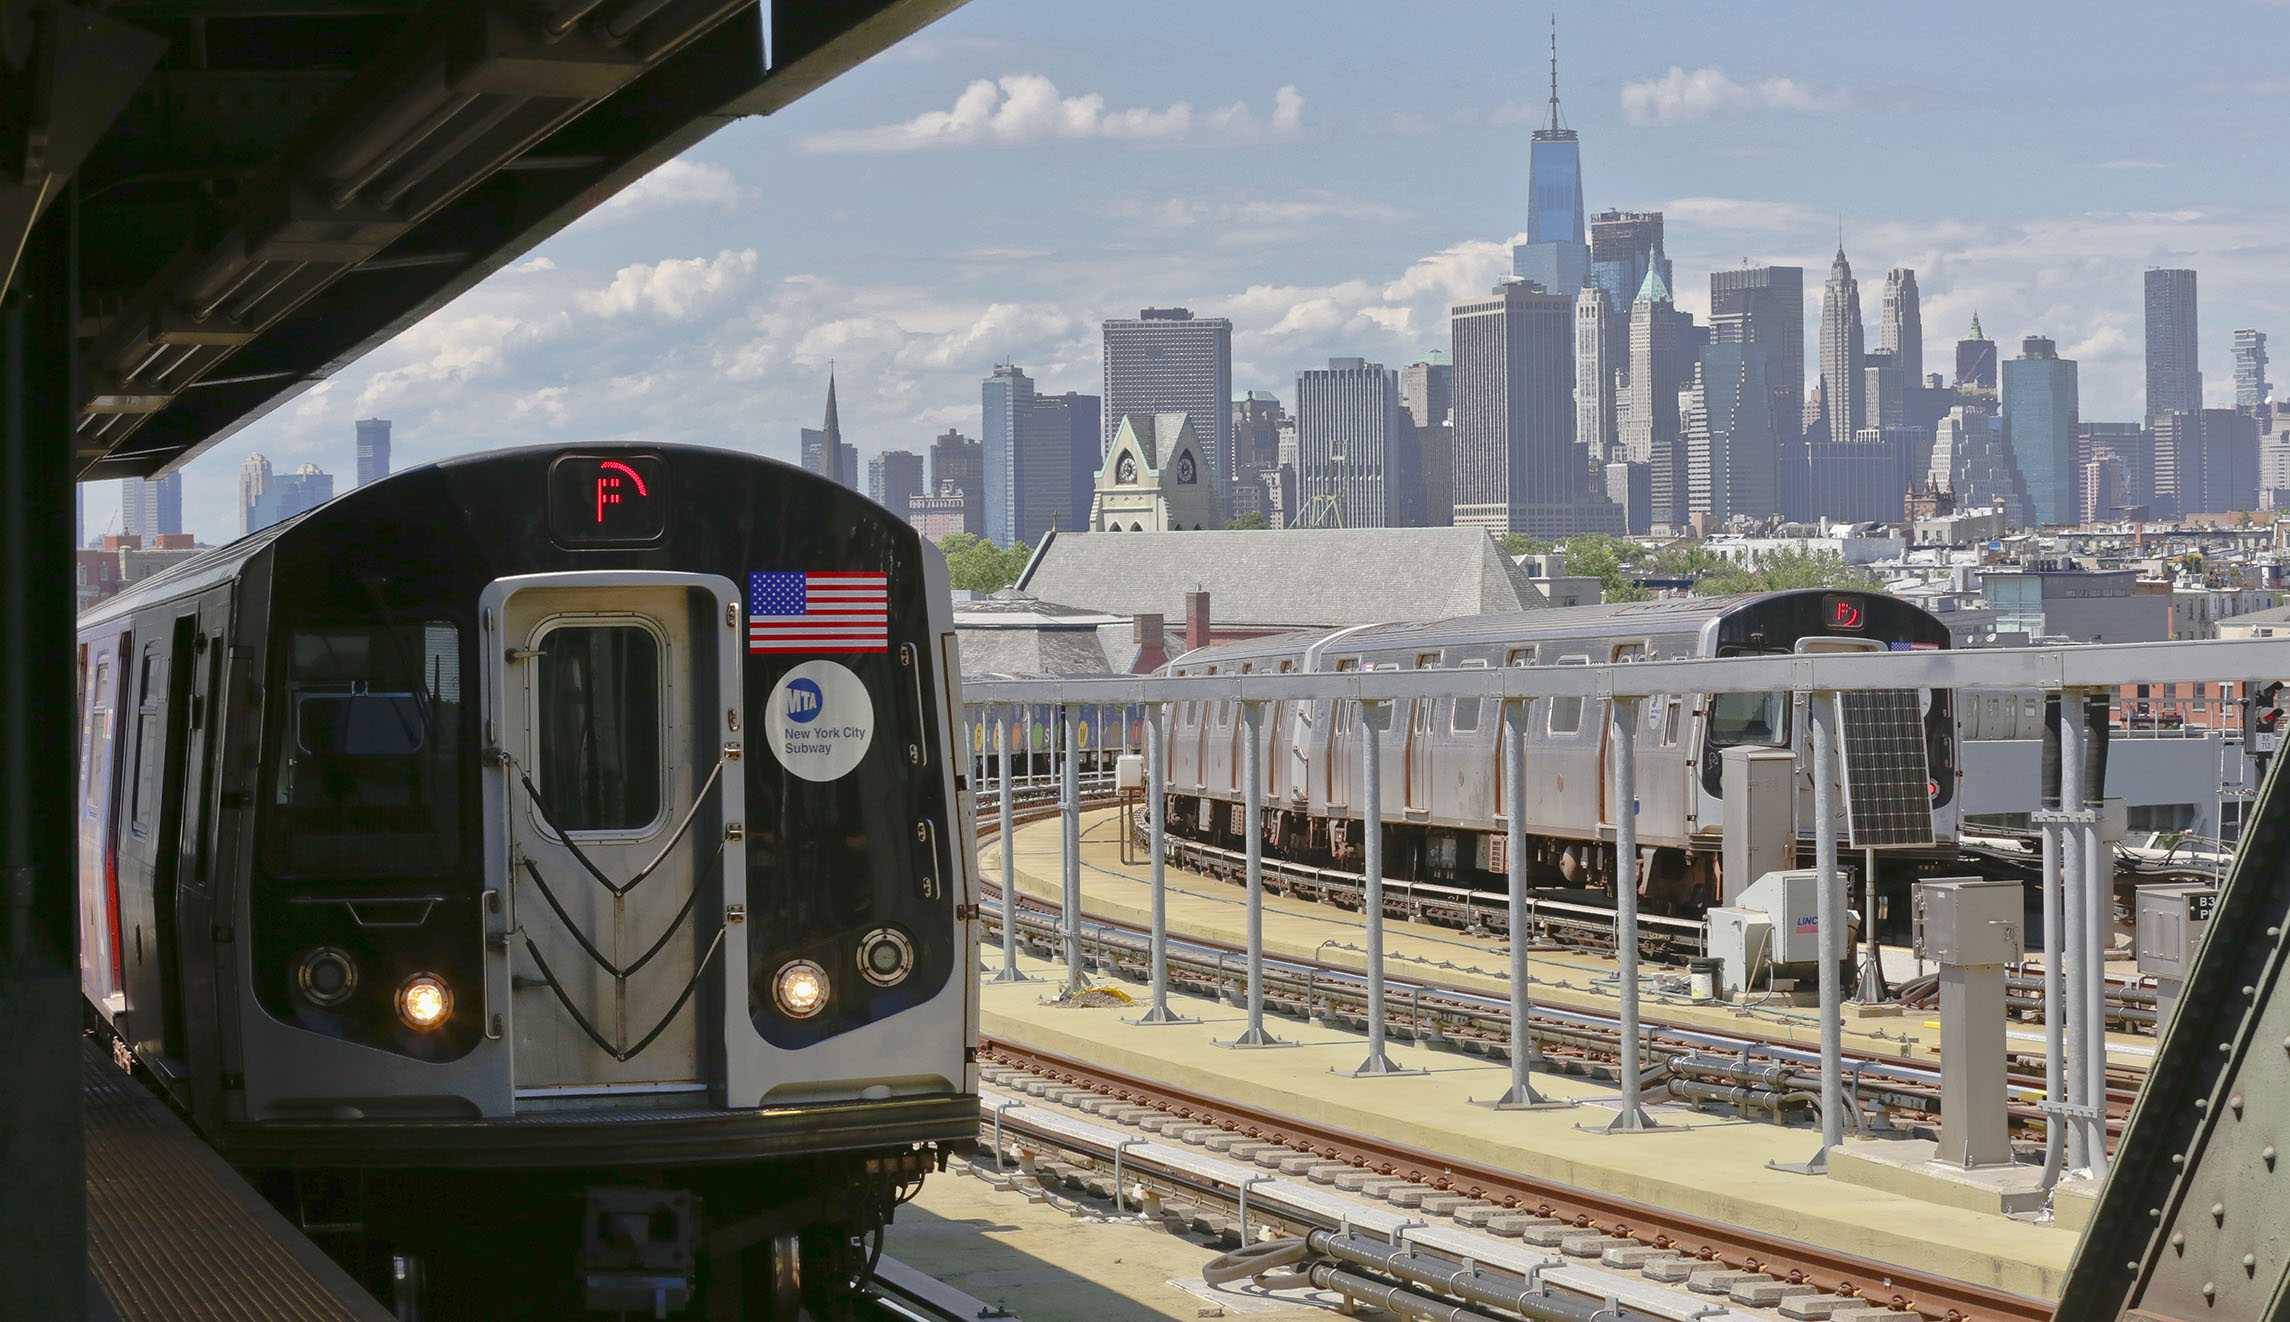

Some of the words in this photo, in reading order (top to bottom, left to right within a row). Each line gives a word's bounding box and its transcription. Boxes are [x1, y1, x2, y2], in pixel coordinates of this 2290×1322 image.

[597, 477, 621, 523] F
[1837, 602, 1849, 620] F
[785, 687, 817, 714] MTA
[785, 728, 811, 740] New
[814, 727, 840, 739] York
[843, 726, 866, 741] City
[785, 742, 832, 756] Subway
[2200, 896, 2216, 907] B3
[1797, 916, 1818, 926] LINC
